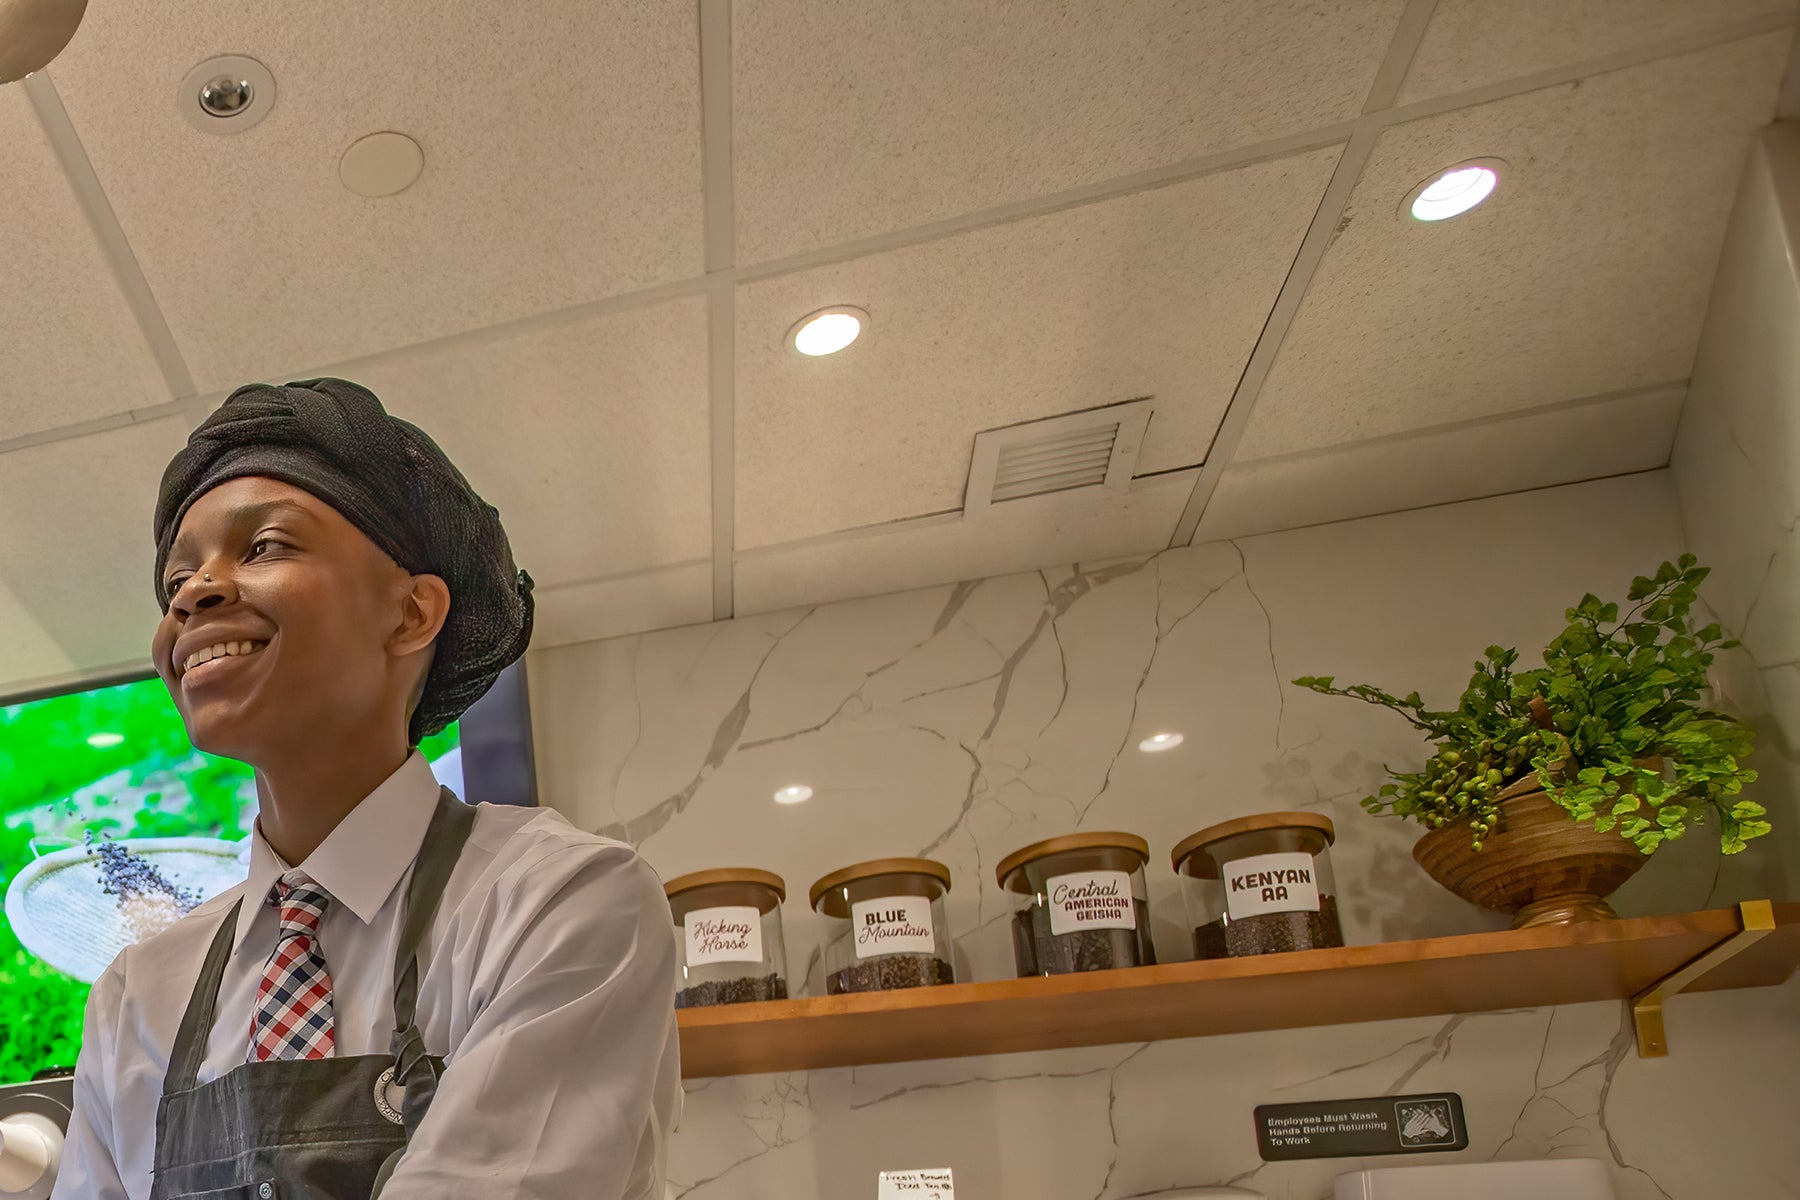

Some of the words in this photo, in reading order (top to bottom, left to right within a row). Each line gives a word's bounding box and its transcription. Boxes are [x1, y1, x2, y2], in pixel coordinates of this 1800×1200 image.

[1231, 868, 1311, 893] KENYAN
[1053, 879, 1120, 906] Central
[1261, 886, 1289, 902] AA
[1064, 897, 1129, 912] AMERICAN
[865, 909, 908, 926] BLUE
[1076, 909, 1122, 922] GEISHA
[694, 918, 752, 940] Kicking
[859, 922, 930, 944] Mountain
[700, 936, 749, 954] Horse
[1267, 1115, 1321, 1127] Employees
[1323, 1113, 1348, 1124] Must
[1350, 1111, 1378, 1121] Wash
[1269, 1126, 1301, 1137] Hands
[1303, 1124, 1336, 1135] Before
[1338, 1121, 1388, 1133] Returning
[1270, 1138, 1283, 1146] To
[1285, 1136, 1311, 1146] Work
